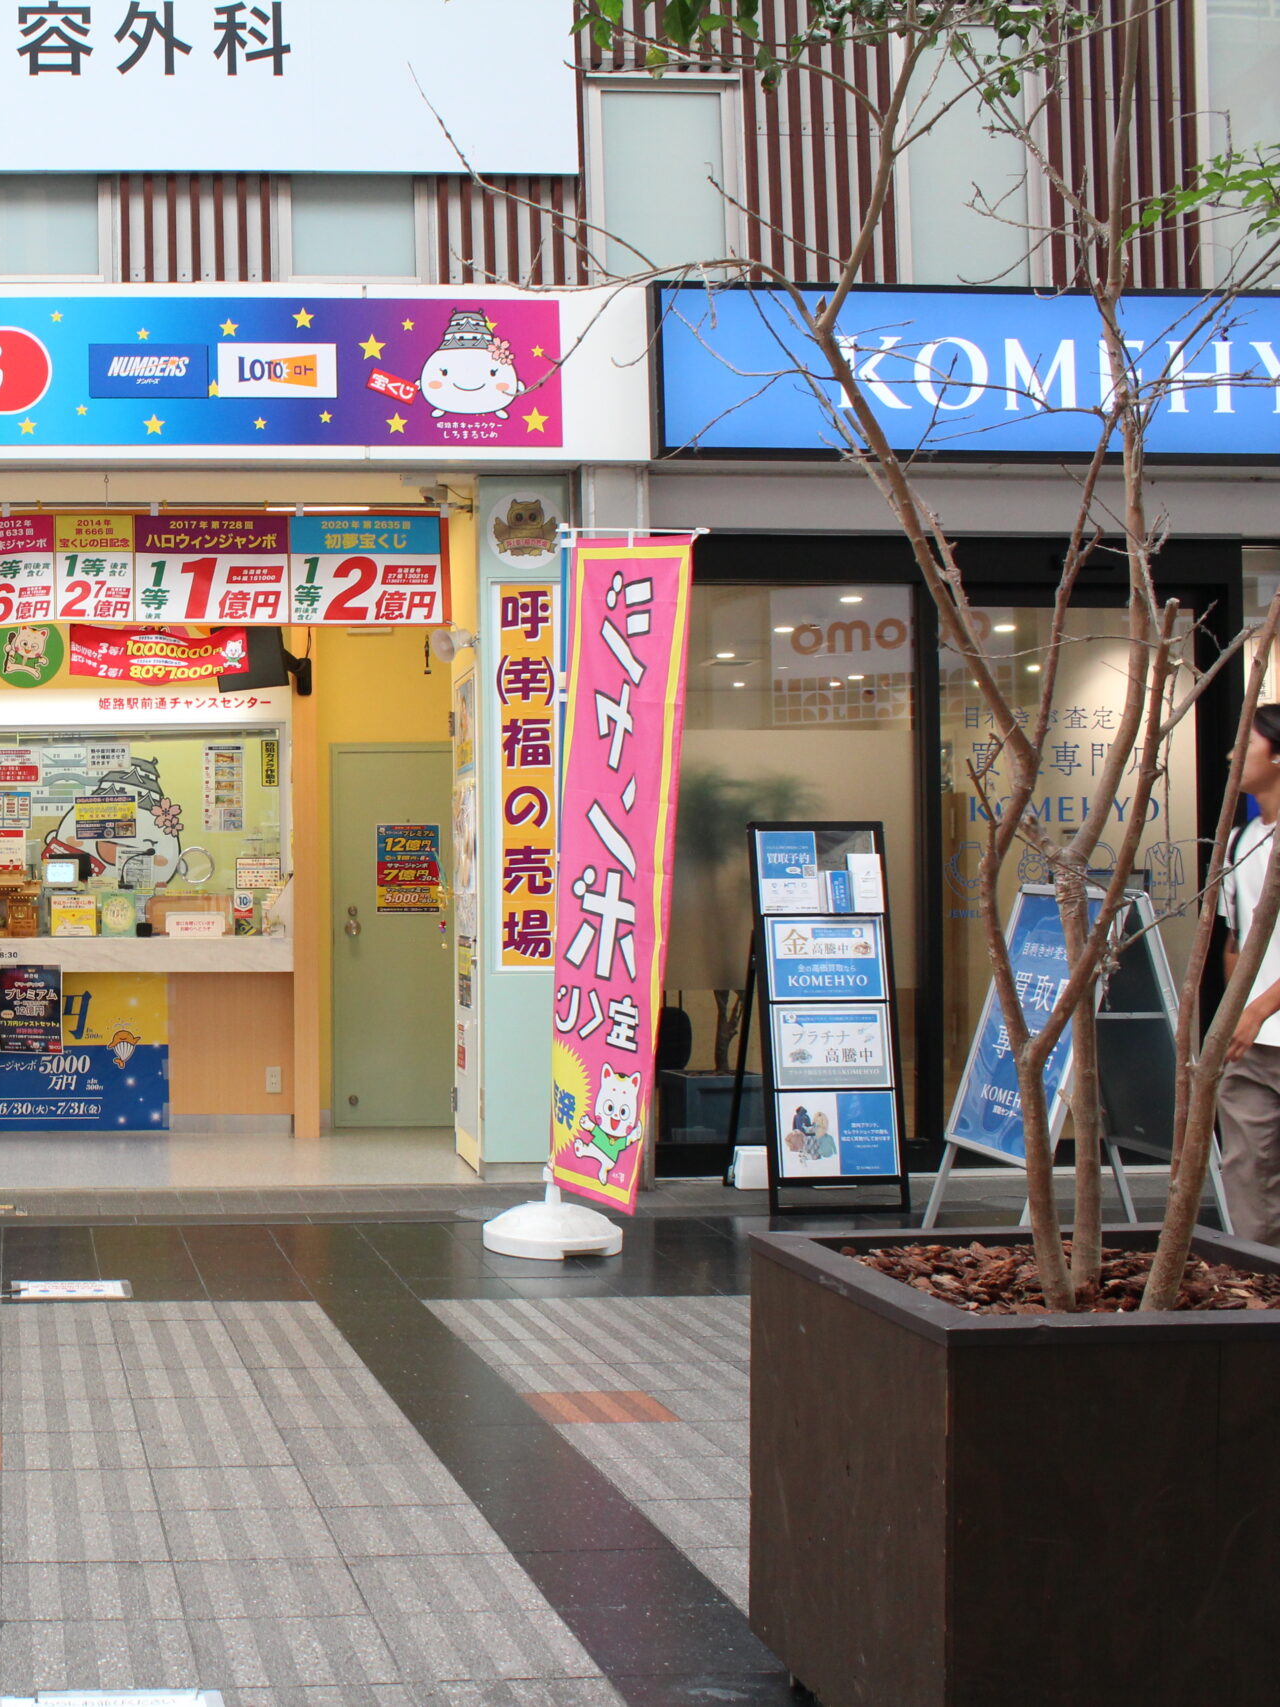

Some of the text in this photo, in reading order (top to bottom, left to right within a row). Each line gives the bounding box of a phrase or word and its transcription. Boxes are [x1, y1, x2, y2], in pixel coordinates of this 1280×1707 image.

[107, 355, 190, 379] NUMBERS
[370, 373, 415, 400] 宝くじ
[59, 538, 130, 549] 宝くじの日記念
[145, 533, 278, 550] ハロウィンジャンボ
[325, 533, 407, 550] 初夢宝くじ
[64, 554, 106, 578] 1等
[99, 697, 271, 710] 姫路駅前通チャンスセンター
[497, 590, 555, 958] 呼(幸)福の売場
[782, 928, 810, 955] 金
[788, 974, 868, 987] KOMEHYO
[5, 988, 59, 1000] プレミアム
[792, 1030, 850, 1045] プラチナ
[825, 1047, 873, 1063] 高騰中
